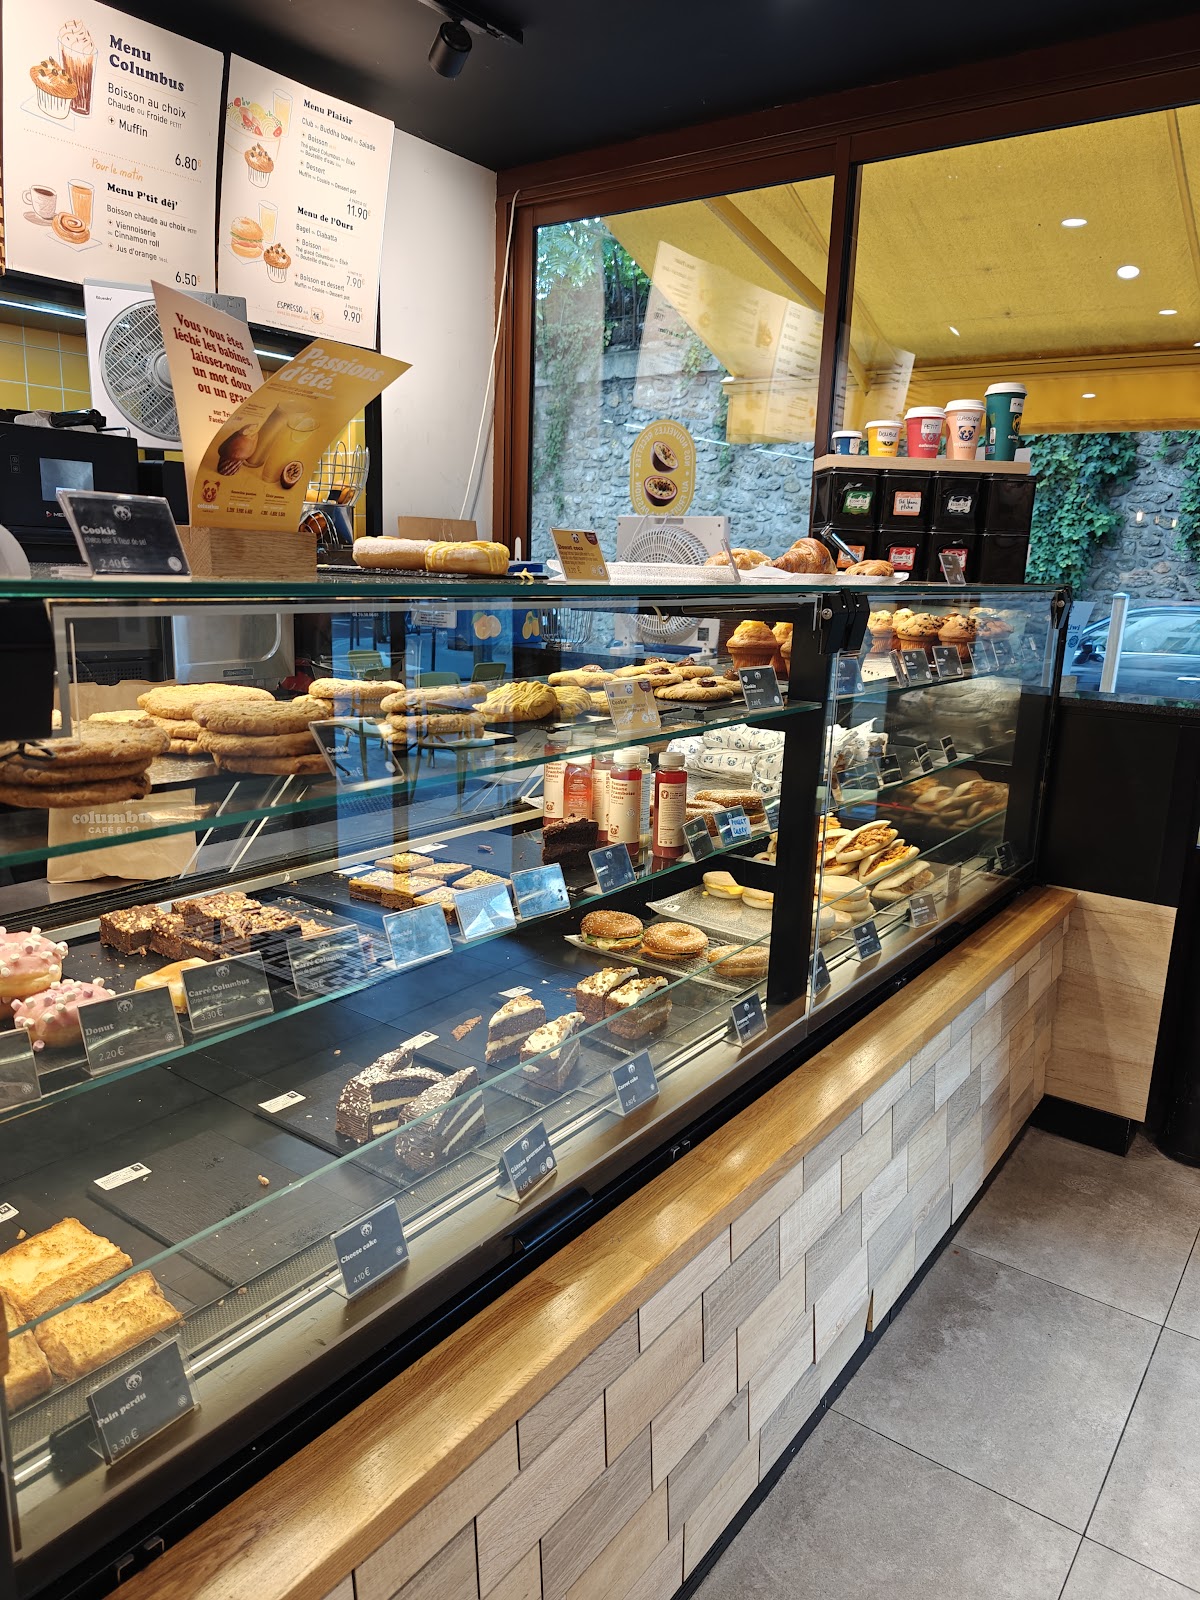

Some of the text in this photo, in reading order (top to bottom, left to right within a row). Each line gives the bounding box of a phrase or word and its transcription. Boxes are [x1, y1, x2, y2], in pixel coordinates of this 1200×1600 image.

[110, 34, 151, 61] Menu
[109, 54, 184, 92] Columbus
[108, 82, 186, 119] Boisson au choix
[108, 97, 135, 113] Chaude
[147, 111, 167, 124] Froide
[303, 99, 353, 125] Menu Plaisir
[119, 119, 148, 137] Muffin
[301, 117, 375, 152] Club Buddha bowl Salade
[308, 134, 328, 148] Boisson
[92, 158, 144, 182] Pour le matin
[306, 162, 325, 175] Dessert
[107, 182, 134, 197] Menu
[137, 190, 158, 204] P'tit
[107, 204, 132, 218] Boisson
[134, 213, 158, 225] chaude
[159, 219, 168, 227] au
[169, 222, 186, 232] choix
[116, 221, 156, 237] Viennoiserie
[297, 206, 354, 231] Menu de l'Ours
[114, 230, 148, 244] Cinnamon
[149, 237, 160, 248] roll
[296, 223, 337, 242] Bagel Ciabatta
[302, 238, 321, 250] Boisson
[116, 245, 127, 254] Jus
[129, 246, 158, 261] d'orange
[300, 273, 319, 285] Boisson
[327, 280, 345, 291] dessert
[277, 300, 303, 313] ESPRESSO
[175, 312, 244, 350] Vous vous êtes
[173, 327, 253, 369] léché les babines,
[191, 348, 247, 377] laissez-nous
[297, 347, 384, 382] Passions
[192, 366, 207, 378] un
[209, 371, 229, 385] mot
[231, 377, 253, 393] doux
[198, 383, 211, 395] ou
[213, 387, 227, 398] un
[81, 525, 117, 535] Cookie
[326, 745, 349, 753] Cookie
[88, 826, 114, 834] CAFÉ
[188, 978, 250, 998] Carré Columbus
[85, 1023, 114, 1036] Donut
[618, 1081, 630, 1090] Carrot
[510, 1141, 546, 1173] Gâteau gourmand
[340, 1238, 377, 1263] Cheese cake
[97, 1392, 147, 1428] Pain perdu
[112, 1427, 139, 1453] 3.30€
